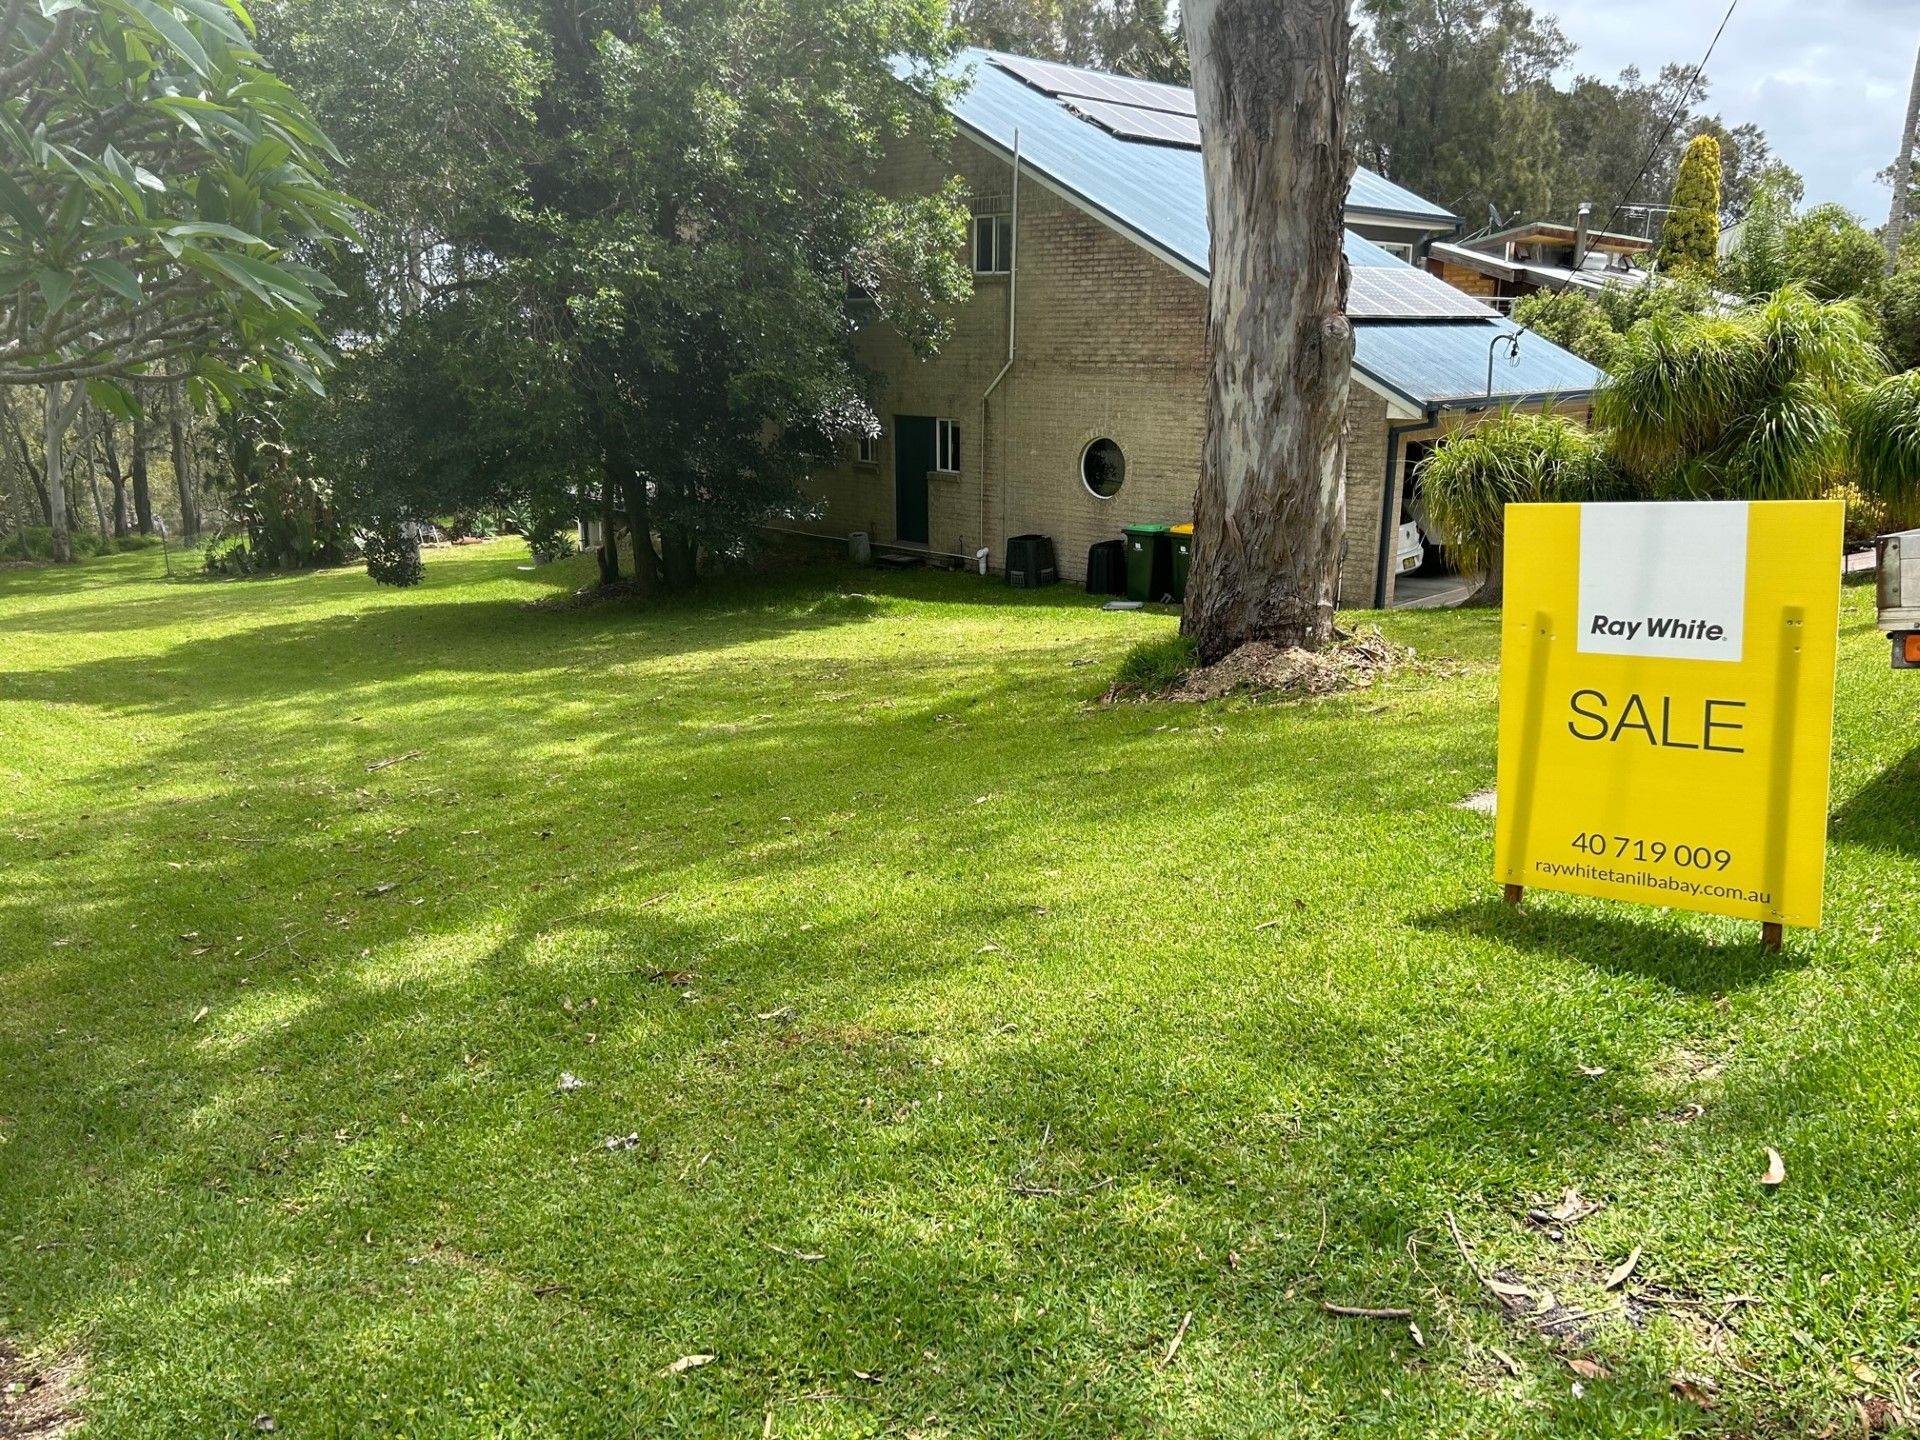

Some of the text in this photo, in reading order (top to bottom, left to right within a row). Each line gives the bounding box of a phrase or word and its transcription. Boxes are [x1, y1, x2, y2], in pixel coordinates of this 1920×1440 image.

[1591, 614, 1724, 641] Ray White
[1568, 689, 1746, 754] SALE
[1571, 832, 1731, 872] 40 719 009
[1535, 859, 1771, 904] raywhitetanilbabay.com.au
